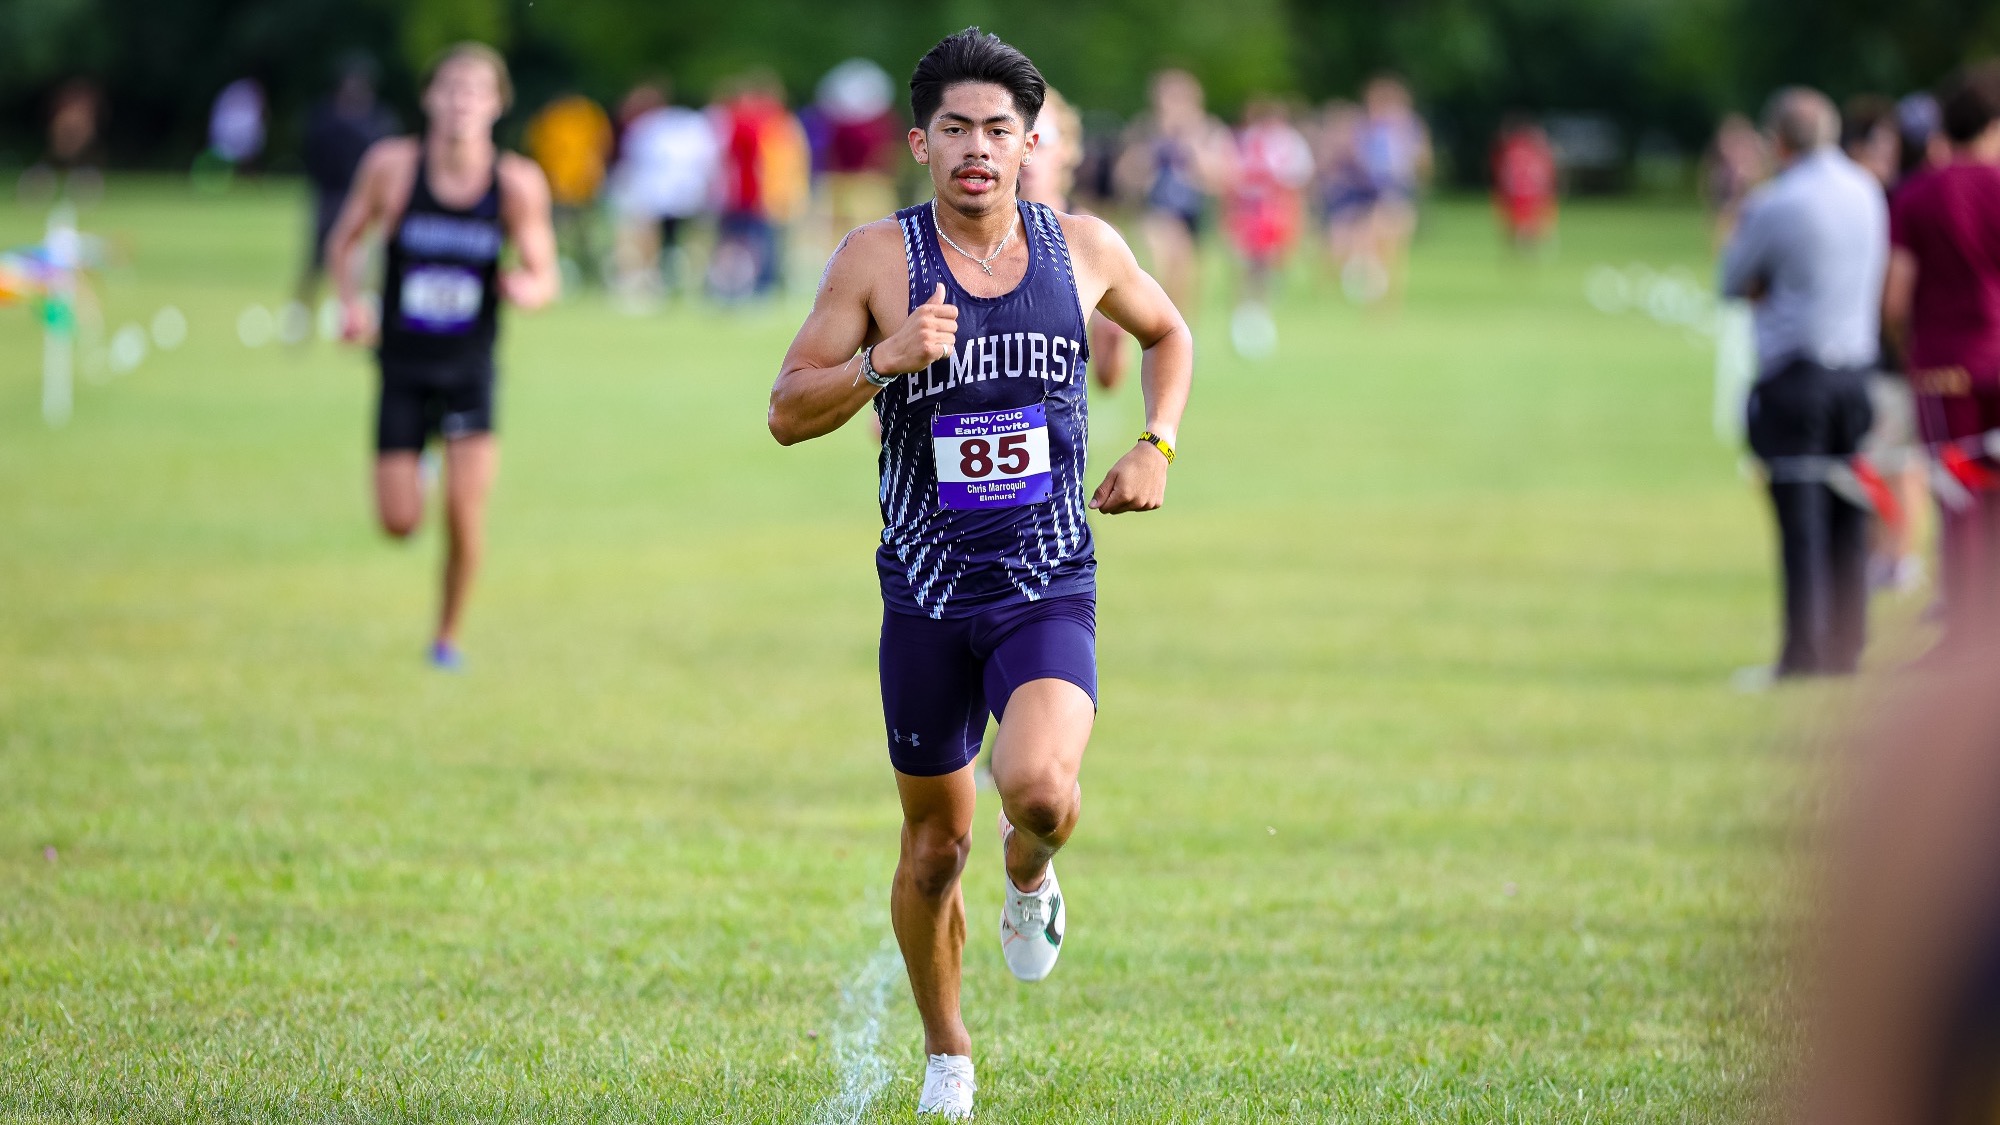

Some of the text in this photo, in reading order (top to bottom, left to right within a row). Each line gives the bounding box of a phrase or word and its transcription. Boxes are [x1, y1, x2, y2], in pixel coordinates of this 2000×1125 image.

[960, 411, 1023, 425] NPU/CUC
[955, 421, 1030, 436] Early Invite
[960, 433, 1030, 478] 85
[967, 480, 1027, 494] Chris Marroquin
[979, 492, 1016, 502] Elmhurst
